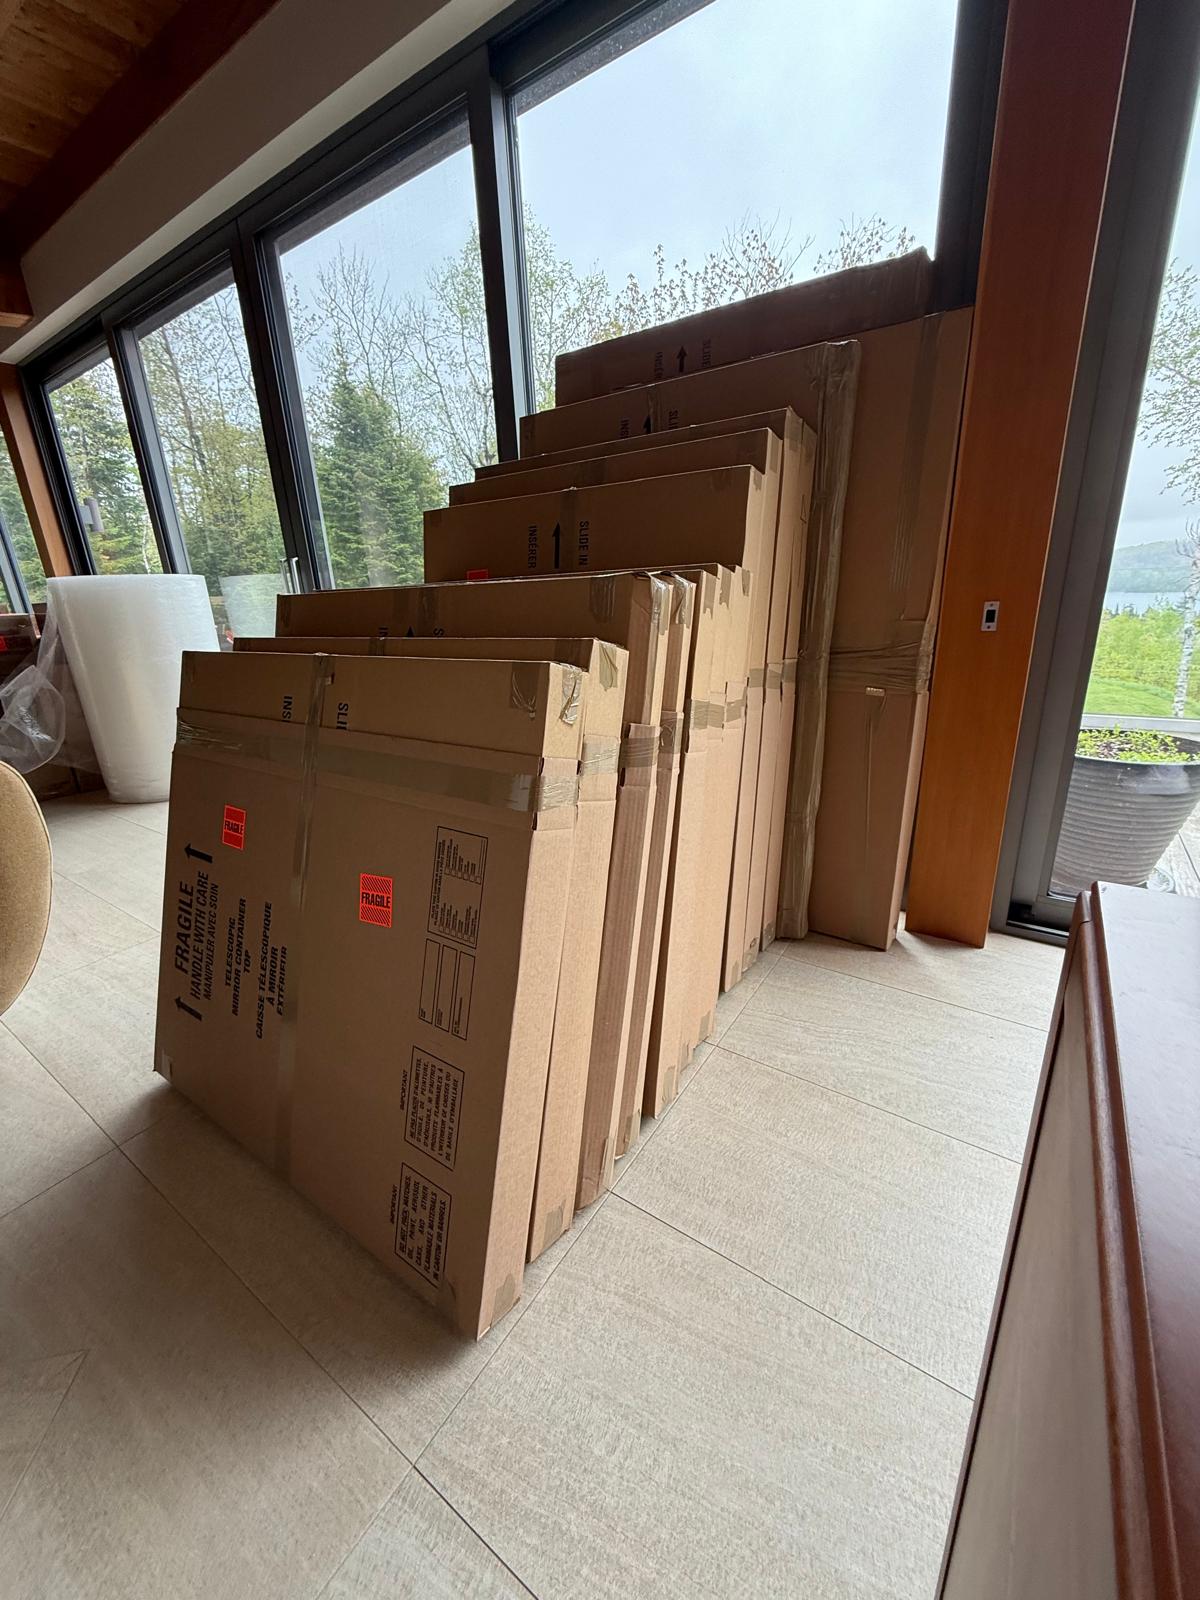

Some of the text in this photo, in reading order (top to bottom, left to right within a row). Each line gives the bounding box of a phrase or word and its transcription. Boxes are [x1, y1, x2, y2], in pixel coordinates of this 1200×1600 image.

[579, 520, 589, 566] SLIDE IN
[282, 695, 293, 723] INS
[224, 819, 244, 836] FRAGILE
[361, 891, 391, 909] FRAGILE
[175, 881, 194, 975] FRAGILE
[190, 871, 209, 1000] HANDLE WITH CARE
[203, 883, 219, 1000] MANIPULER AVEC SOIN
[225, 917, 236, 987] TELESCOPIC
[232, 898, 246, 1016] MIRROR CONTAINER
[243, 949, 251, 973] TOP
[256, 902, 272, 1039] CAISSE TÉLESCOPIQUE
[268, 946, 278, 994] MIROIR
[400, 1069, 408, 1111] IMPORTANT
